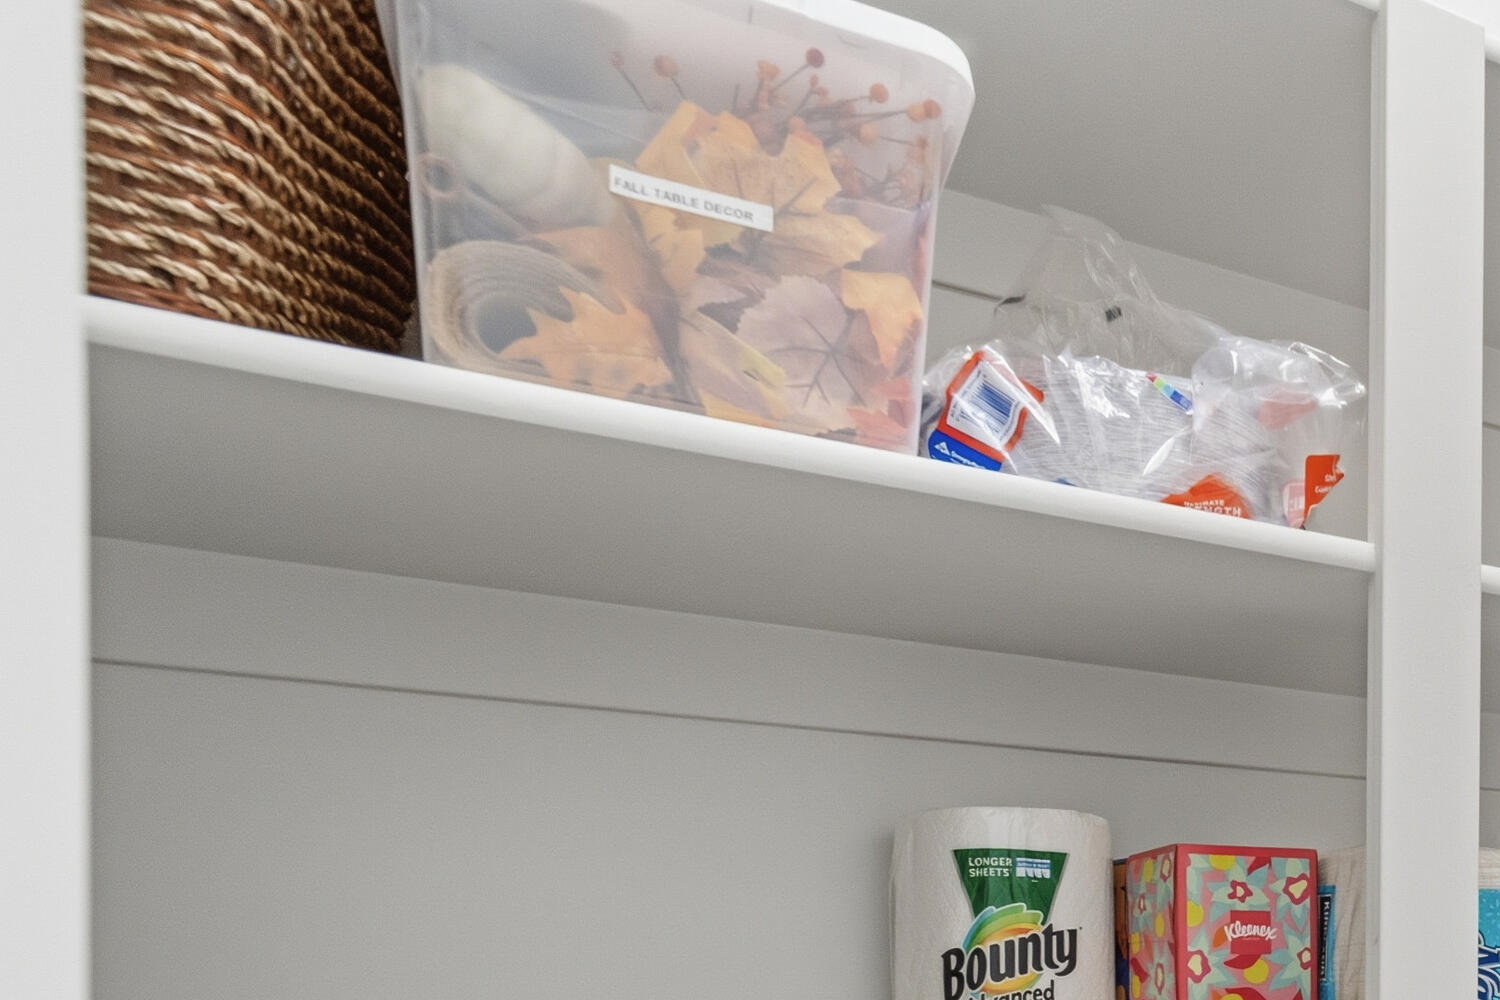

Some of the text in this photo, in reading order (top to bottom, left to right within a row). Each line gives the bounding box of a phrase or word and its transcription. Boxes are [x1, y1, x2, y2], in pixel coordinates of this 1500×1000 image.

[613, 176, 755, 223] FALL TABLE DECOR
[968, 856, 1012, 867] LONGER
[968, 867, 1011, 878] SHEETS
[1223, 920, 1277, 941] Kleenex
